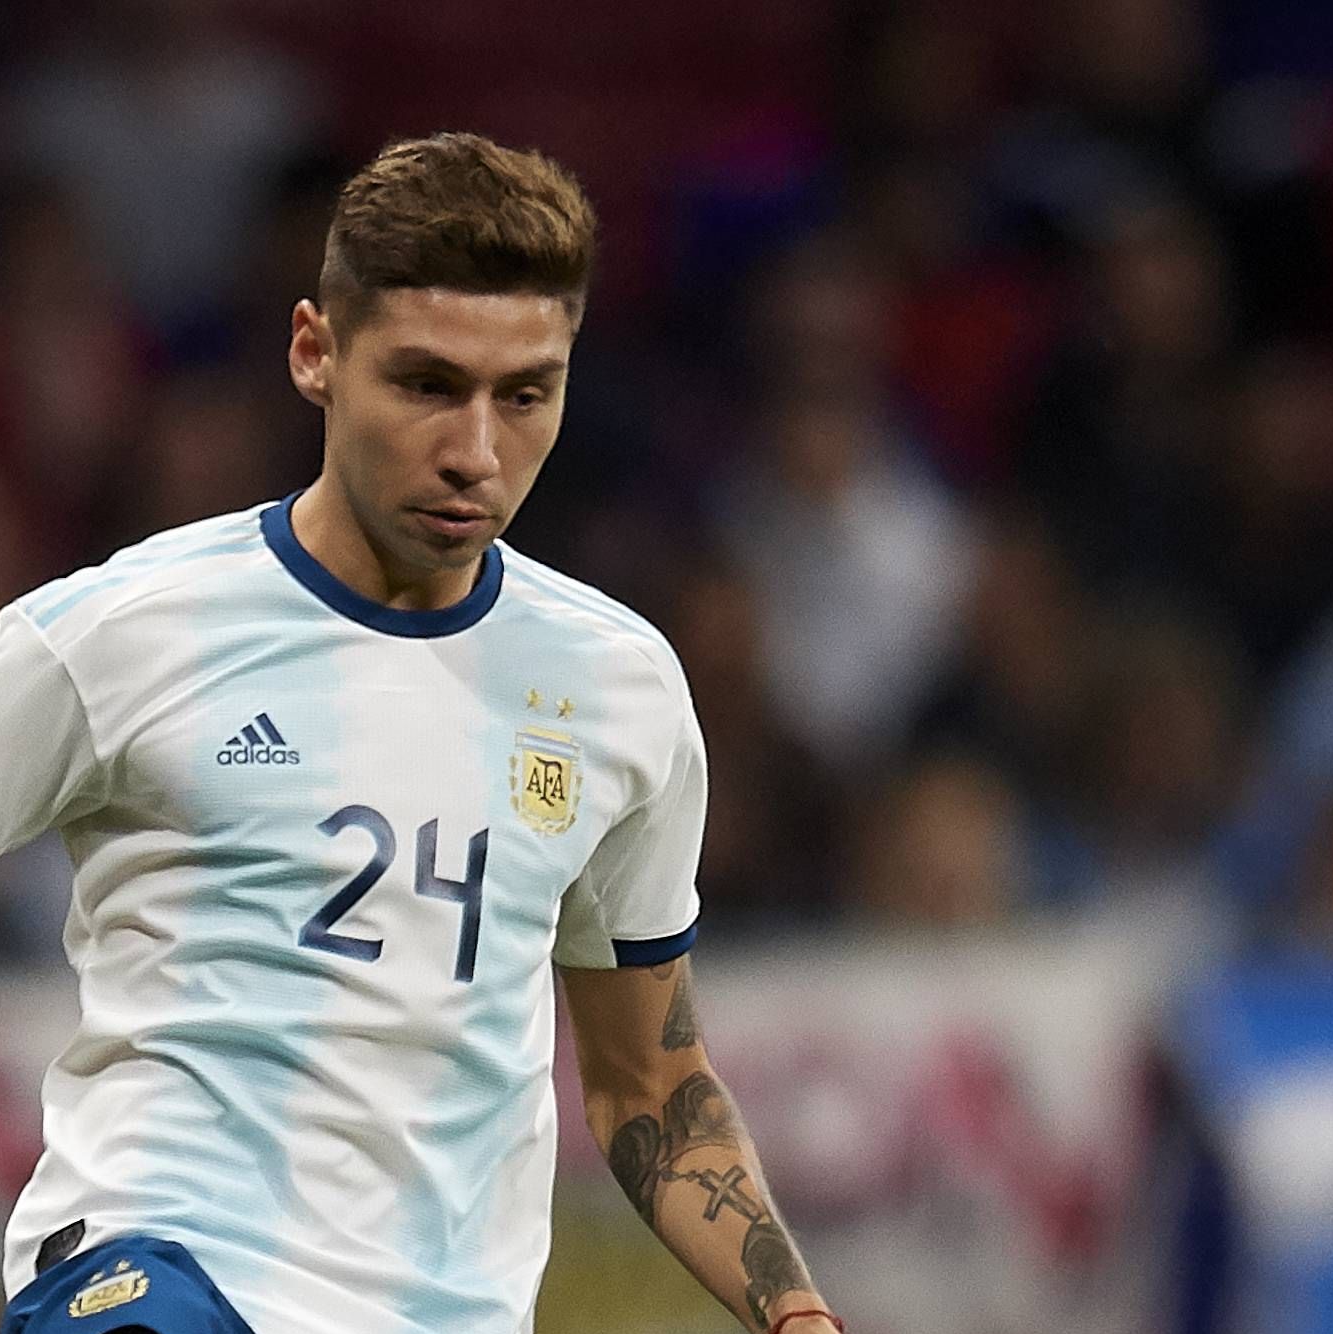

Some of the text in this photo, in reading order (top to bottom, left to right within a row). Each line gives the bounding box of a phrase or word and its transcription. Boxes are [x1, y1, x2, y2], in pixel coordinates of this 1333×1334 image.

[216, 745, 300, 766] adidas
[526, 755, 566, 807] AFA
[297, 803, 490, 984] 24
